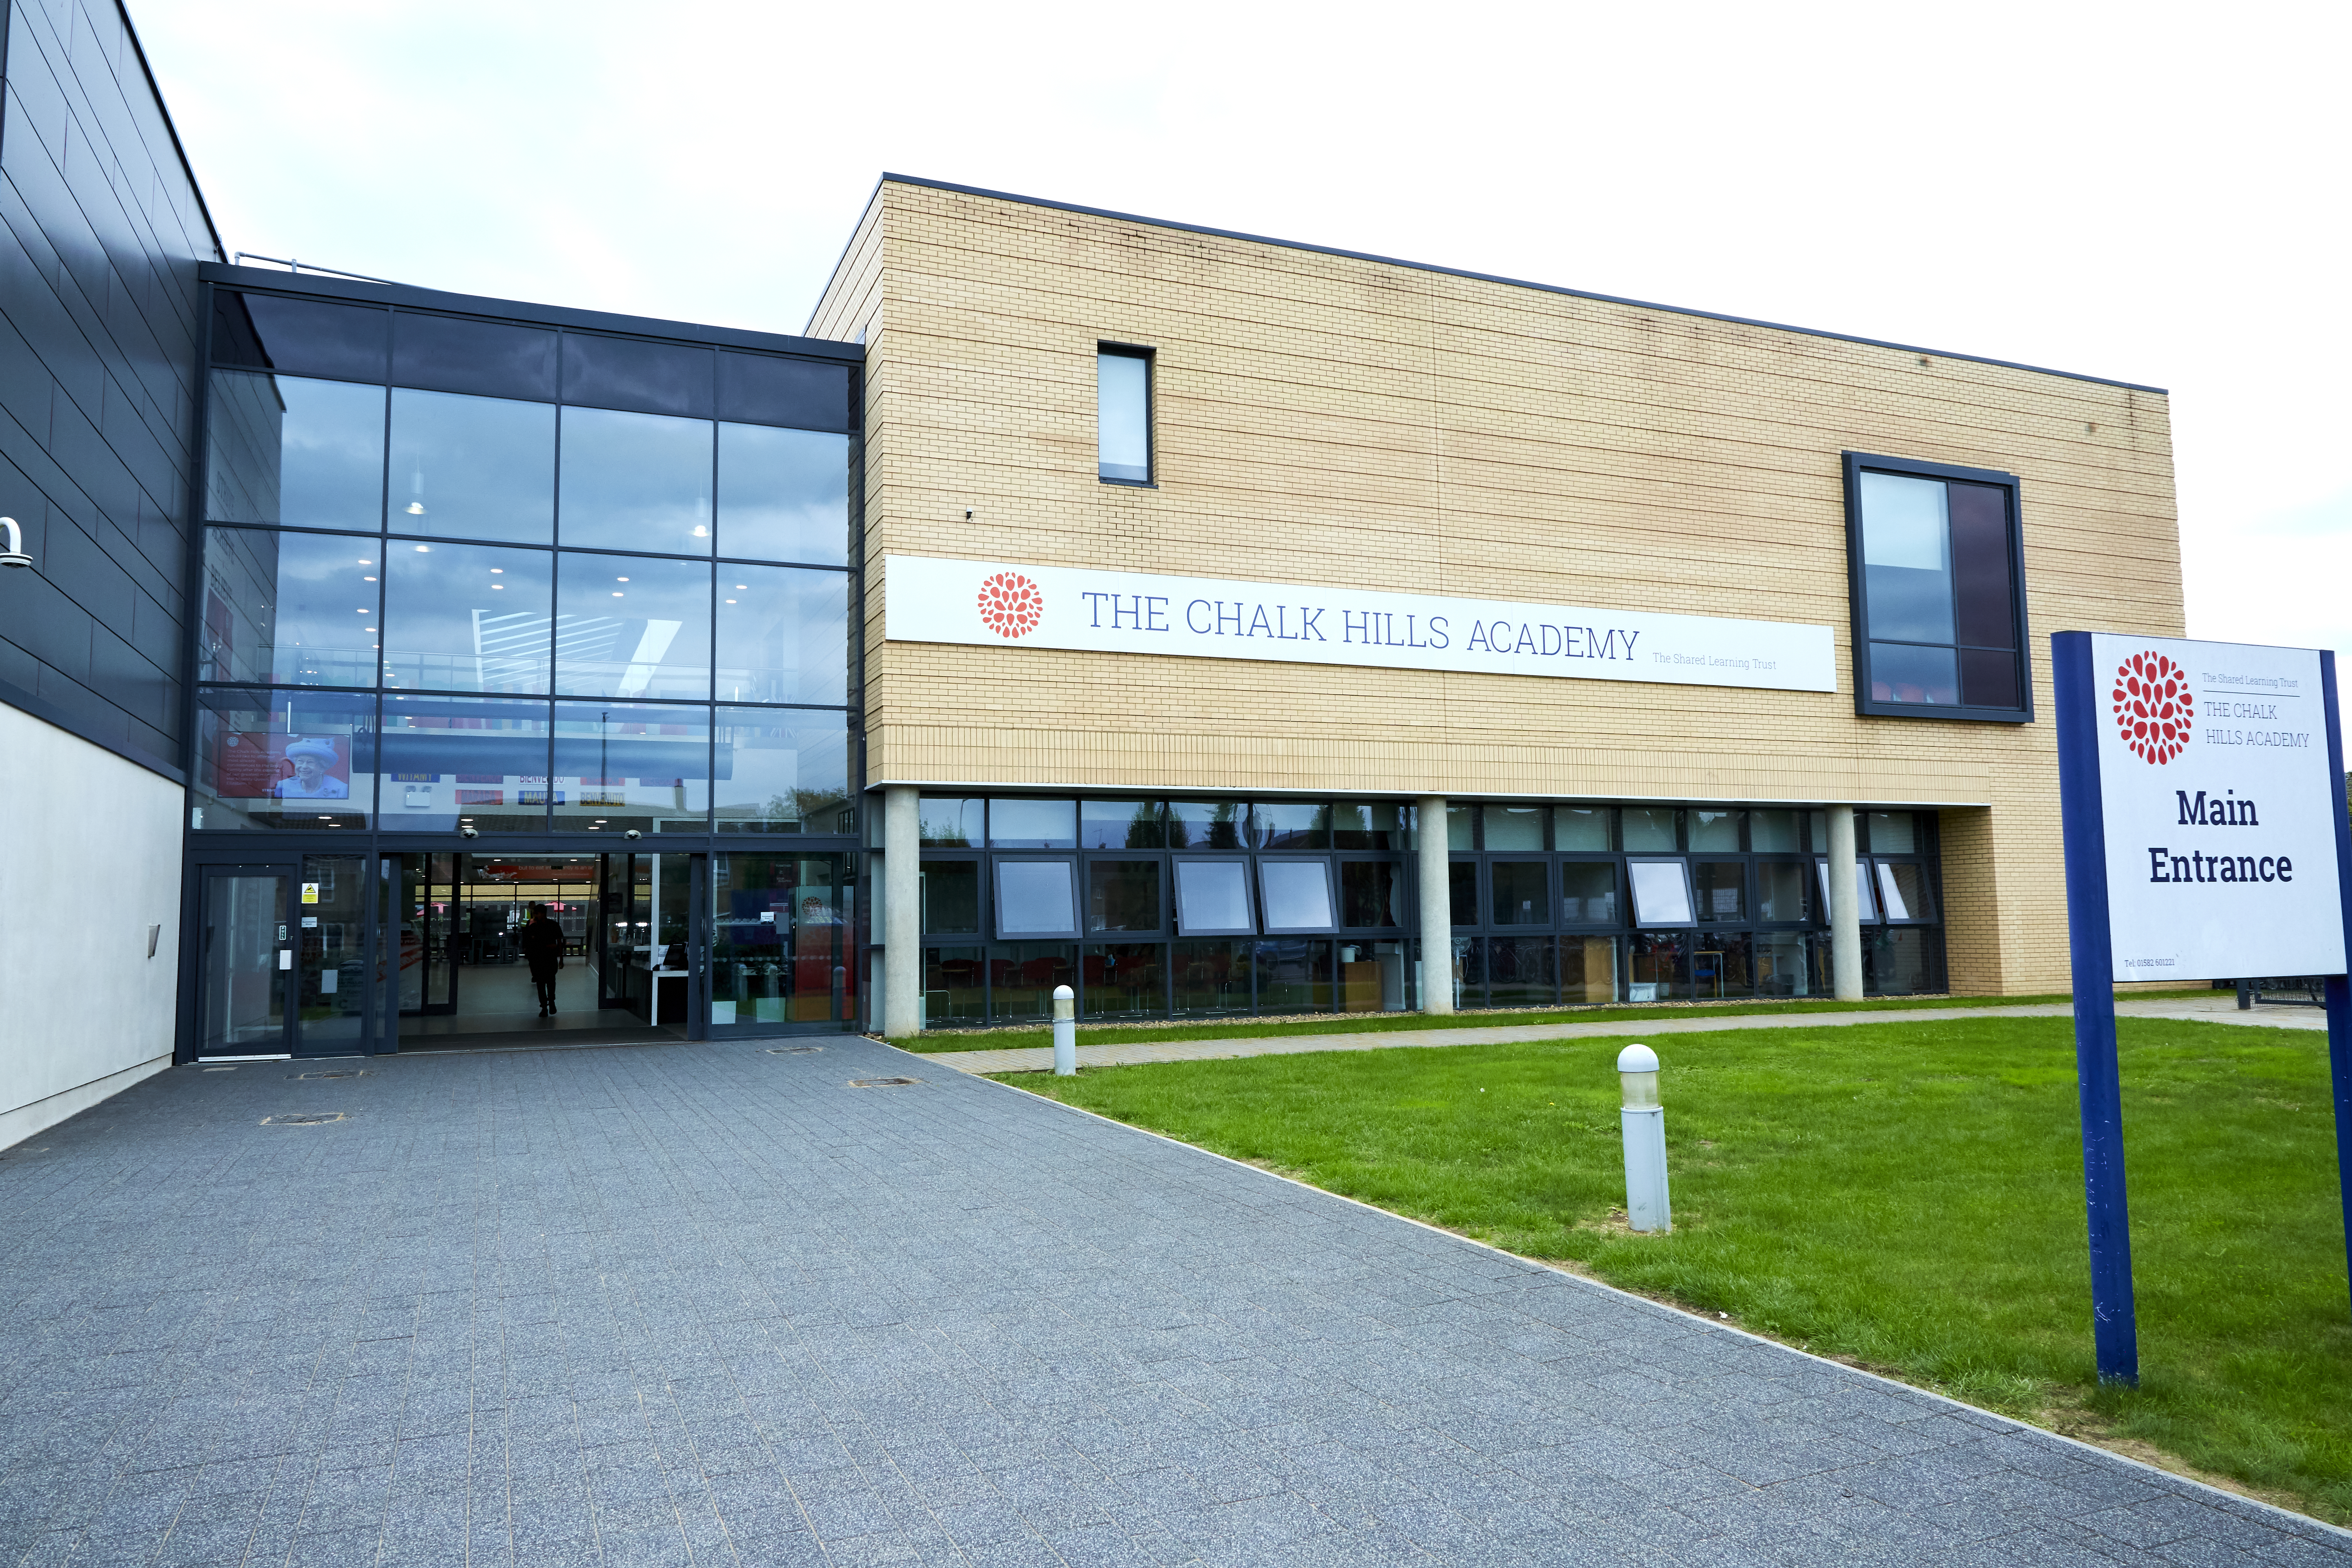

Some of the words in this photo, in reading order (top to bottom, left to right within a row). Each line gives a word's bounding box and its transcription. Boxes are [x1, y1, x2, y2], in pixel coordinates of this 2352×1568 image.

[1082, 592, 1169, 632] THE
[1187, 599, 1327, 641] CHALK
[1343, 610, 1450, 649] HILLS
[1467, 620, 1640, 661] ACADEMY
[1653, 653, 1670, 663] The
[1673, 653, 1705, 665] Shared
[1709, 656, 1749, 670] Learning
[1753, 659, 1776, 669] Trust
[2202, 673, 2216, 683] The
[2218, 674, 2243, 685] Shared
[2246, 676, 2278, 689] Learning
[2280, 678, 2298, 688] Trust
[2204, 702, 2231, 718] THE
[2234, 704, 2278, 720] CHALK
[2206, 729, 2243, 746] HILLS
[2247, 731, 2310, 748] ACADEMY
[524, 791, 558, 804] MAUA
[580, 792, 625, 805] BENVENUTO
[2176, 789, 2259, 826] Main
[2148, 847, 2293, 883] Entrance
